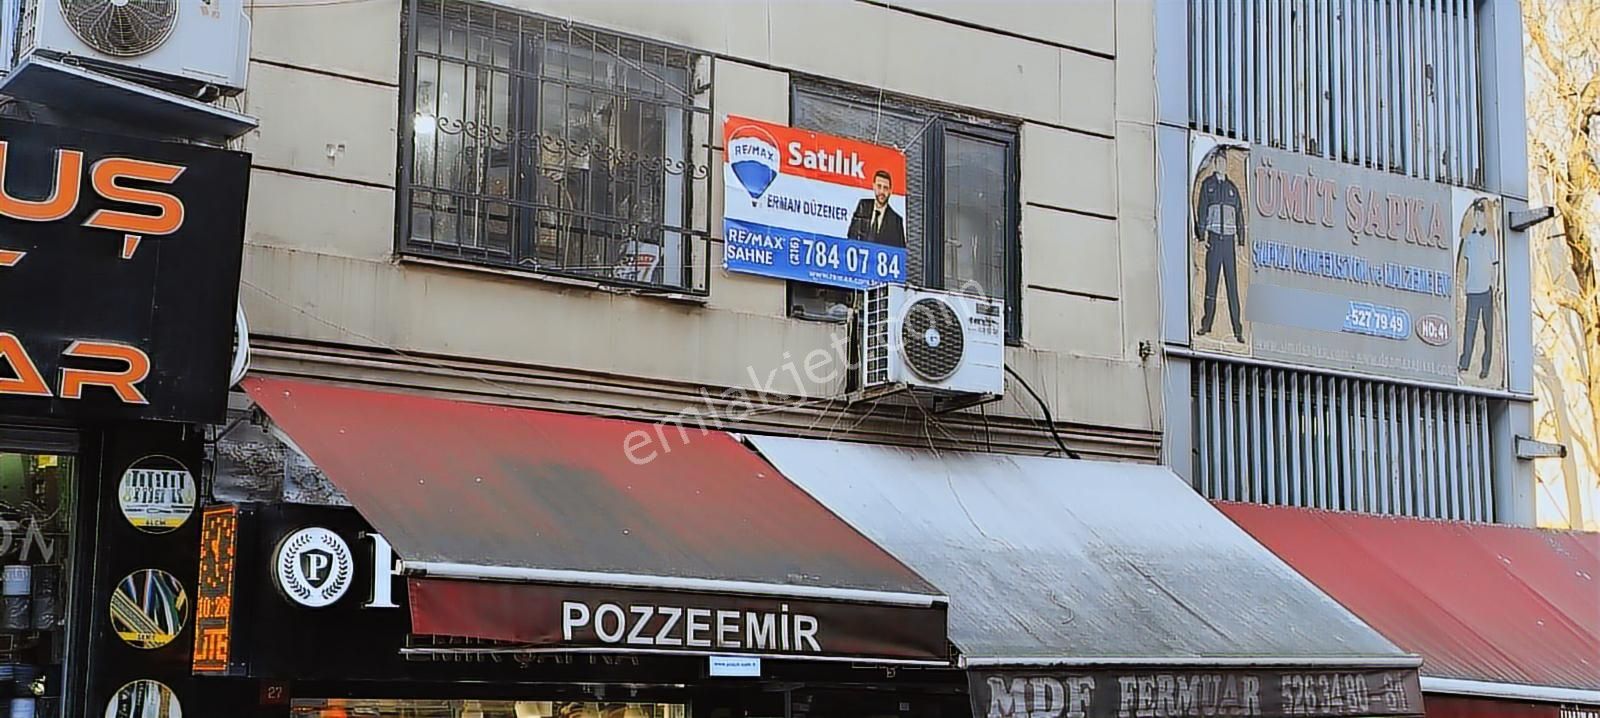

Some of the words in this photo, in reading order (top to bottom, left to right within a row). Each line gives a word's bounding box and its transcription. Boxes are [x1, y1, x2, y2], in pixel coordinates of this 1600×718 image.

[734, 143, 775, 162] RE/MAX
[788, 142, 866, 179] Satılık
[767, 194, 801, 214] ERMAN
[803, 198, 848, 221] DÜZENER
[1254, 156, 1337, 229] ÜMİT
[1344, 184, 1449, 250] ŞAPKA
[728, 229, 784, 250] RE/MAX
[727, 246, 774, 265] SAHNE
[803, 239, 840, 270] 784
[846, 247, 869, 274] 07
[877, 252, 900, 279] 84
[306, 553, 329, 581] P
[562, 601, 823, 653] POZZEEMİR
[267, 686, 282, 699] 27
[986, 675, 1095, 718] MDF
[1118, 673, 1262, 716] FERMUAR
